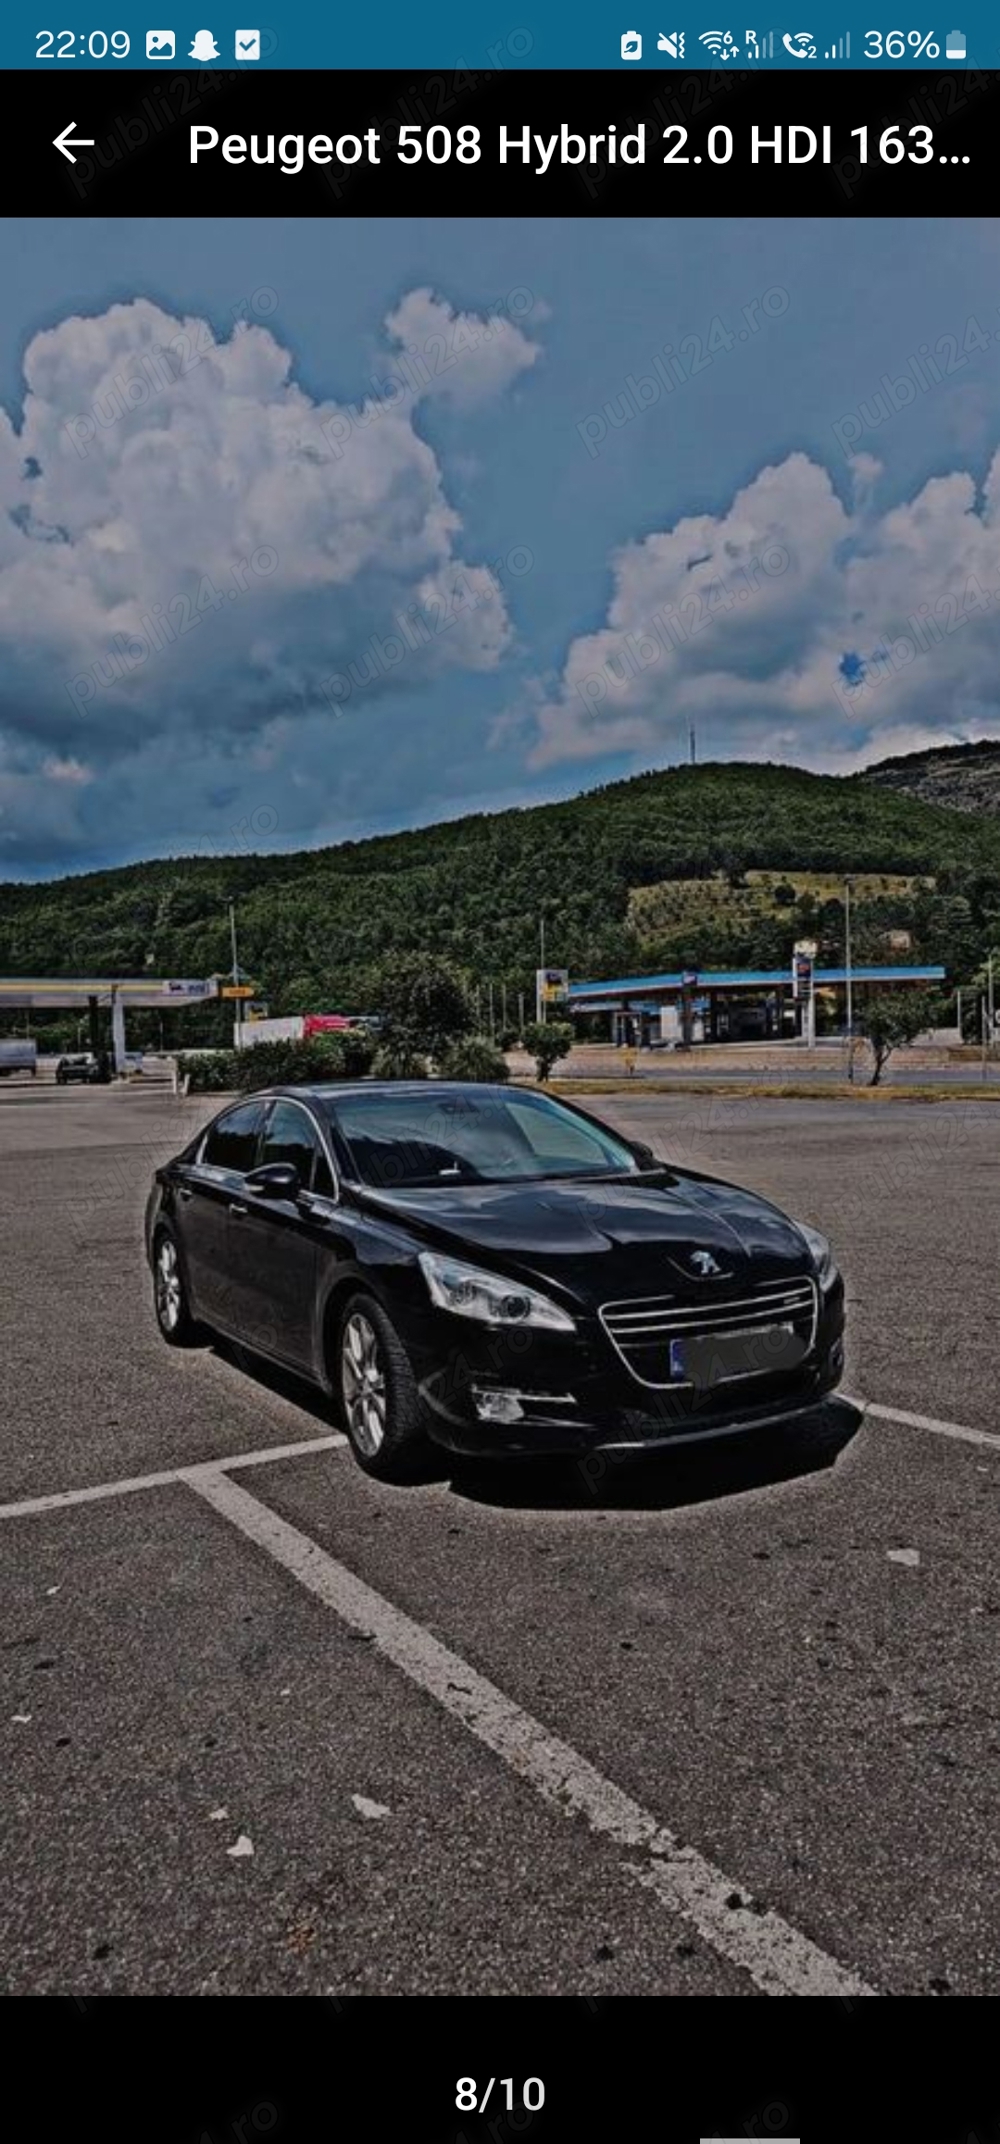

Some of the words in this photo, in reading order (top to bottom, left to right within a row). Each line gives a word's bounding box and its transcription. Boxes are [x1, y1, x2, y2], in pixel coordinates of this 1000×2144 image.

[35, 30, 131, 59] 22:09
[864, 30, 940, 59] 36%
[190, 125, 381, 175] Peugeot
[396, 124, 482, 165] 508
[499, 123, 646, 175] Hybrid
[662, 124, 734, 165] 2.0
[751, 125, 831, 165] HDI
[455, 2076, 546, 2114] 8/10
